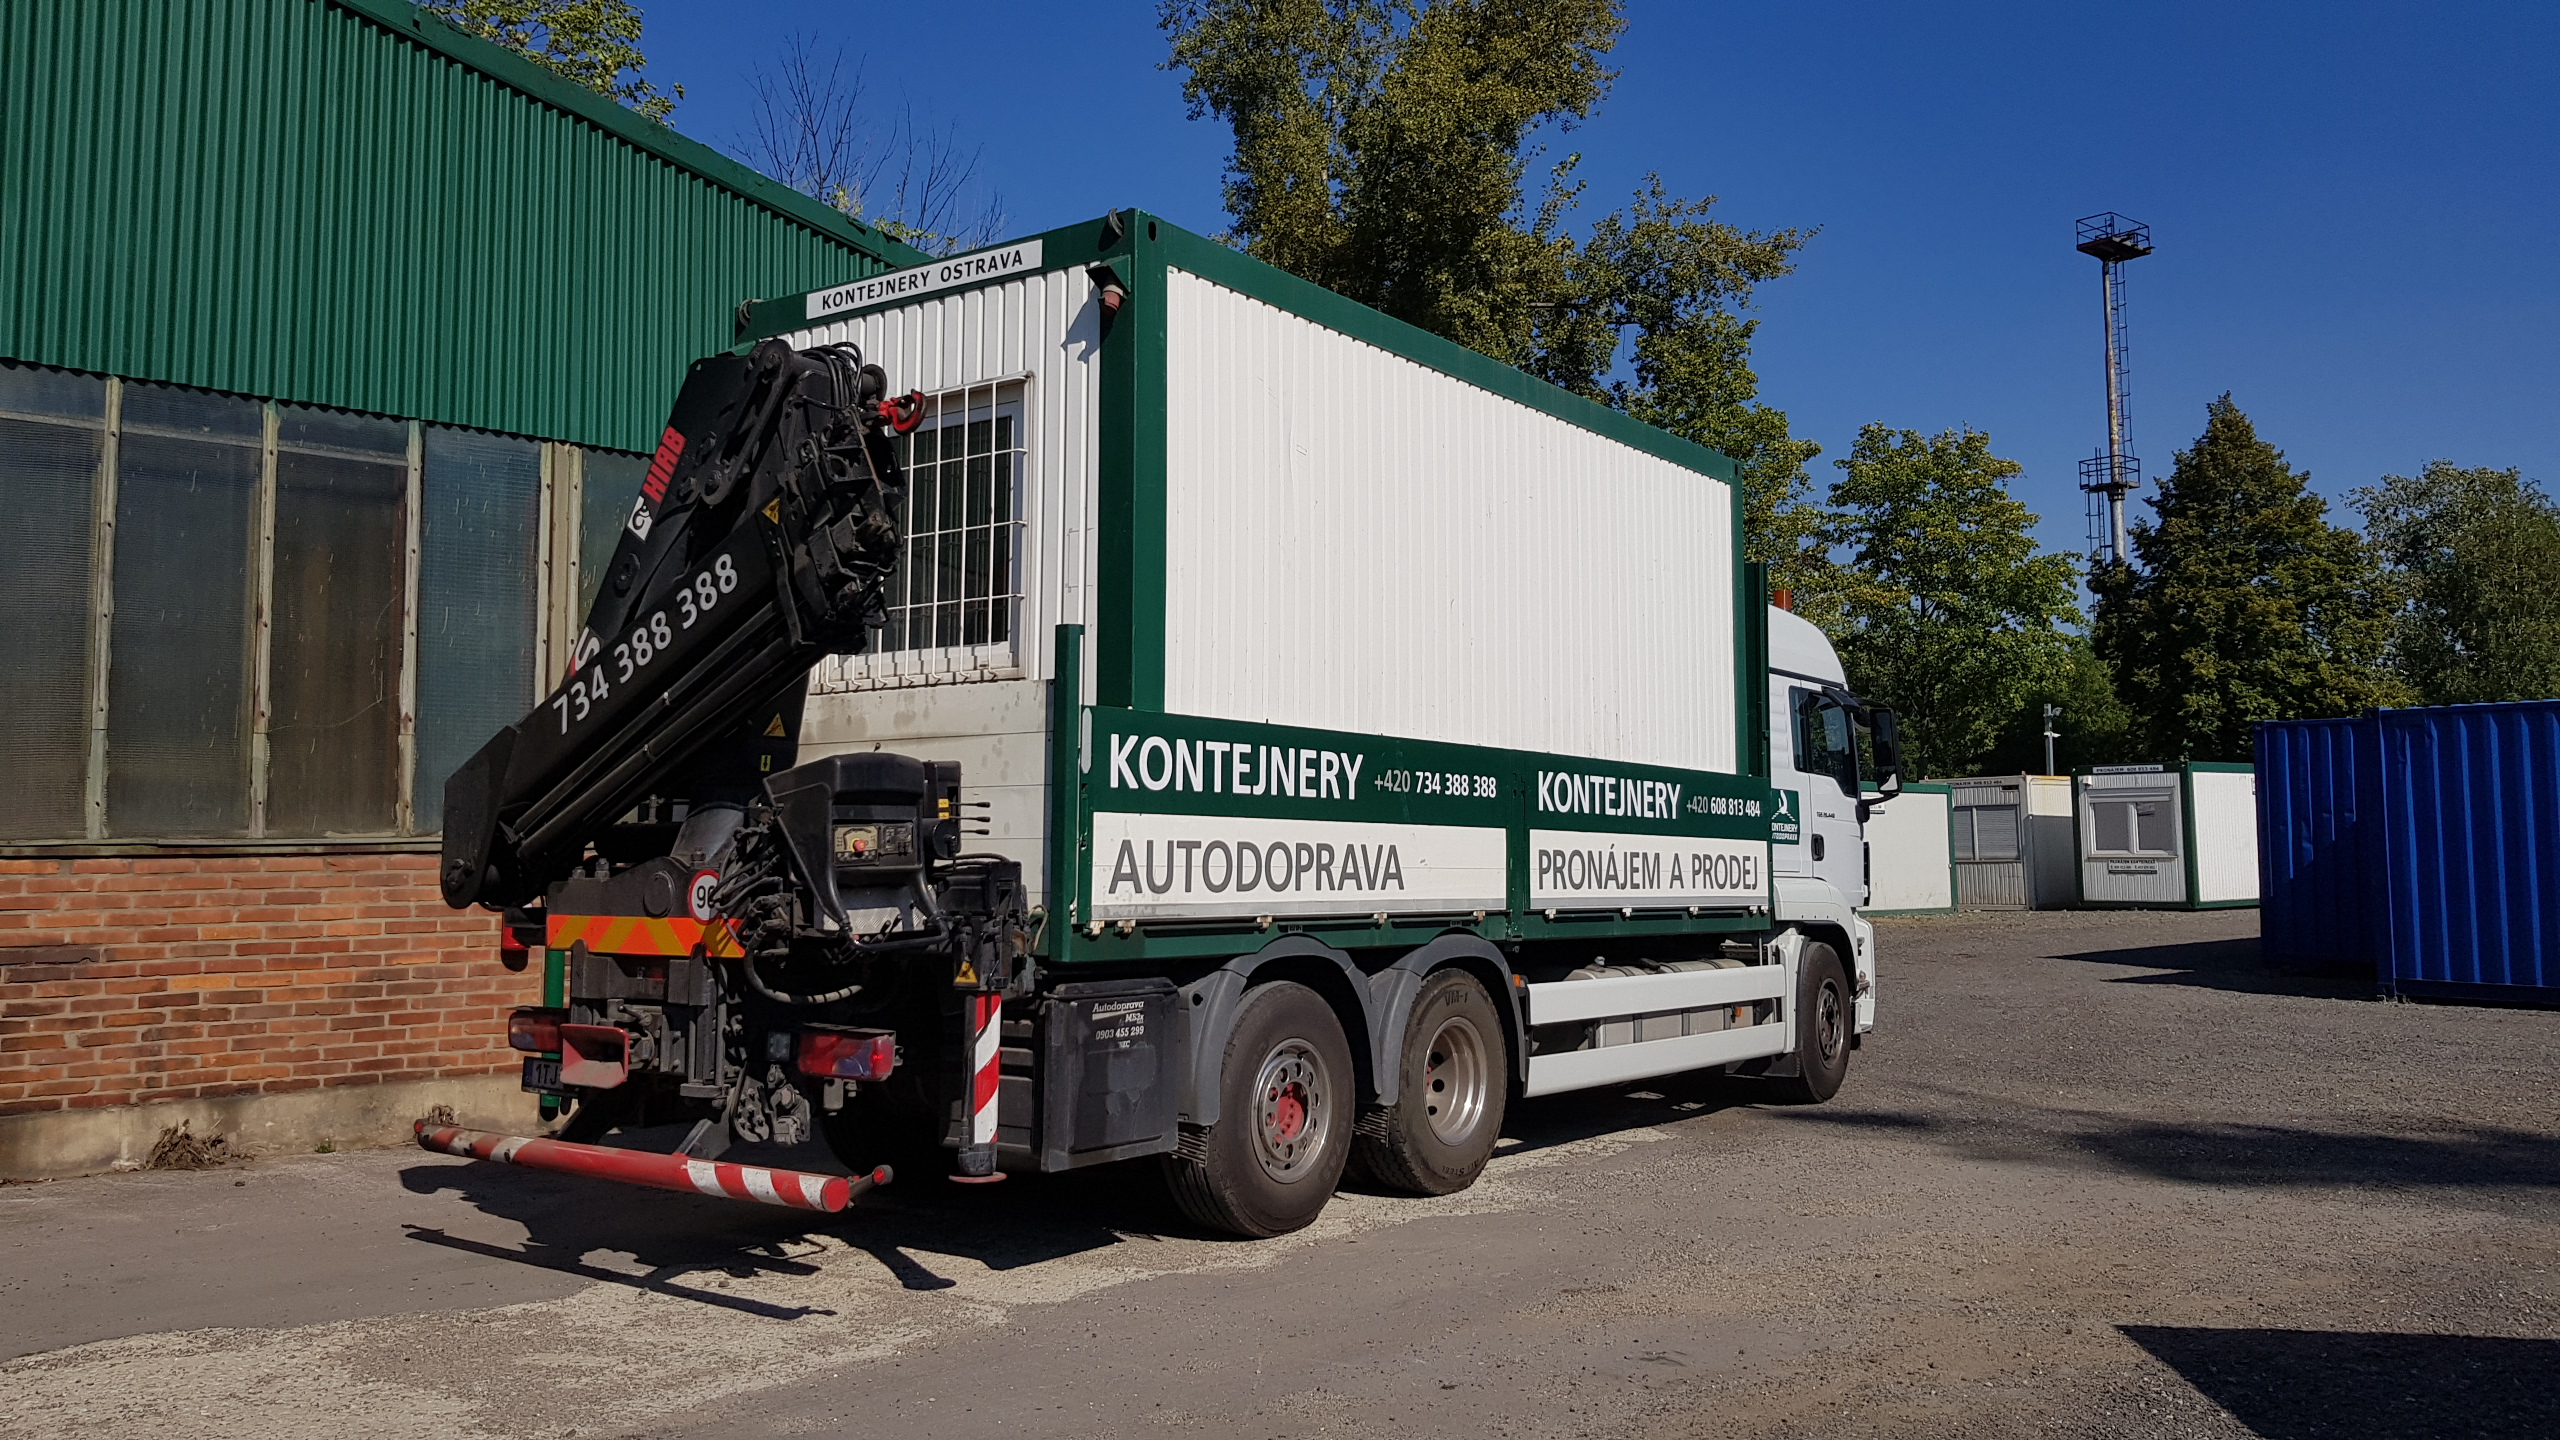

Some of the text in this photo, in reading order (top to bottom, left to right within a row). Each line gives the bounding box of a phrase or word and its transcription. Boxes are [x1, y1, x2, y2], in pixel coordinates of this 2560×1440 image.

[821, 249, 1023, 311] KONTEJNERY OSTRAVA
[642, 425, 687, 504] HIAB
[552, 552, 738, 736] 734 388 388
[1110, 733, 1497, 800] KONTEJNERY +420 734 388 388
[1538, 770, 1761, 820] KONTEJNERY +420 608 813 484
[1108, 839, 1405, 895] AUTODOPRAVA
[1538, 844, 1758, 891] PRONÁJEM A PRODEJ
[1092, 1001, 1144, 1013] Autodoprava
[1095, 1025, 1145, 1040] 0903 455 299
